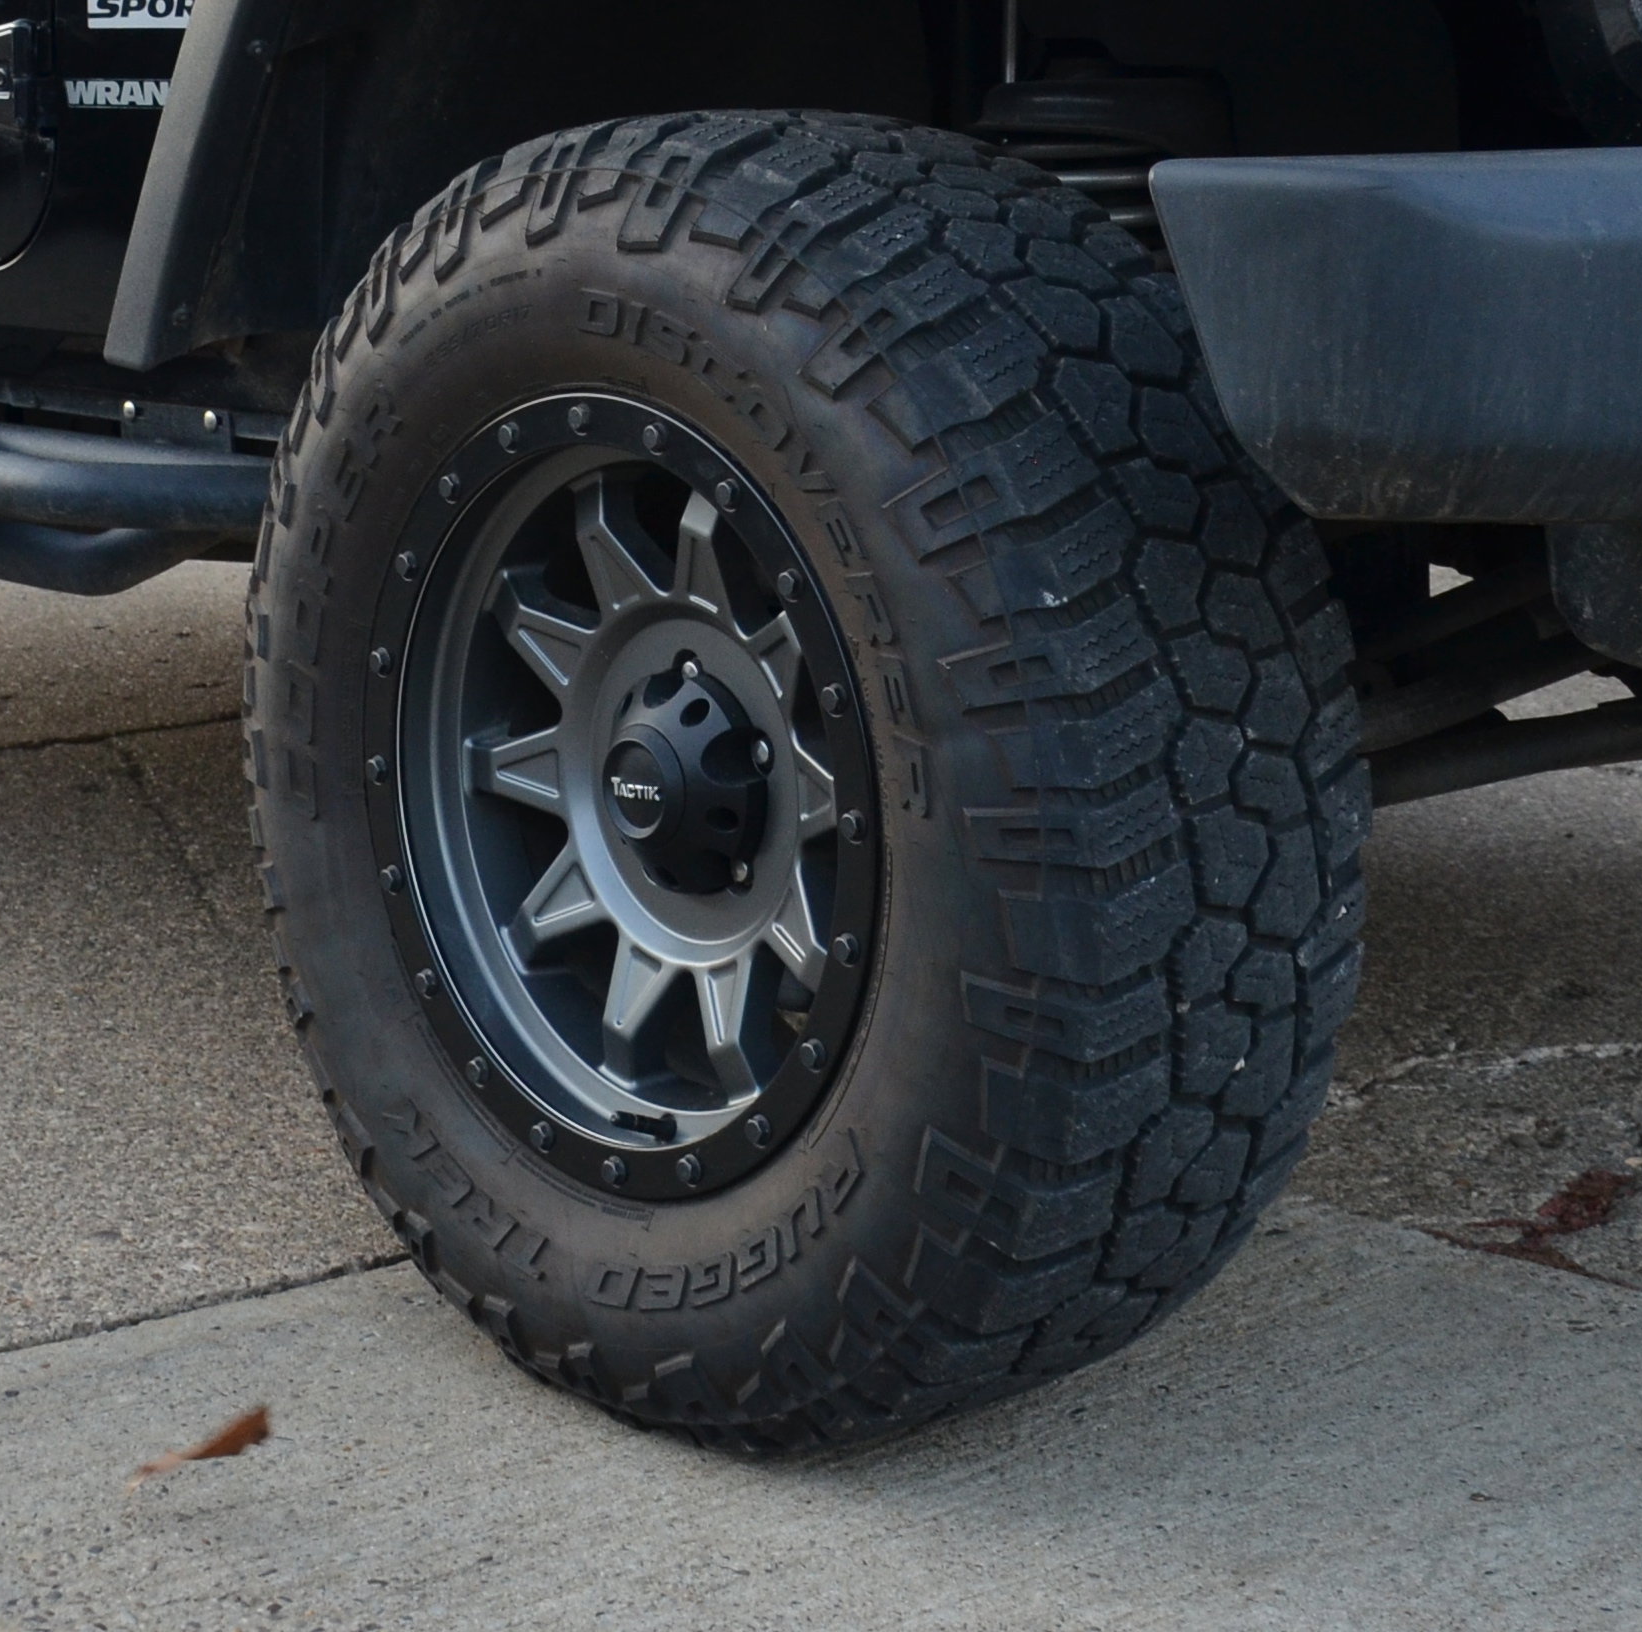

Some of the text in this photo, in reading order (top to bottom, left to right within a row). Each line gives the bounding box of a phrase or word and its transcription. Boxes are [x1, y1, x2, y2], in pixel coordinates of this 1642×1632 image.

[64, 79, 172, 106] WRAN
[573, 285, 932, 820] DISCOVERER
[610, 776, 661, 802] TACTIK
[585, 1126, 868, 1314] RUGGED
